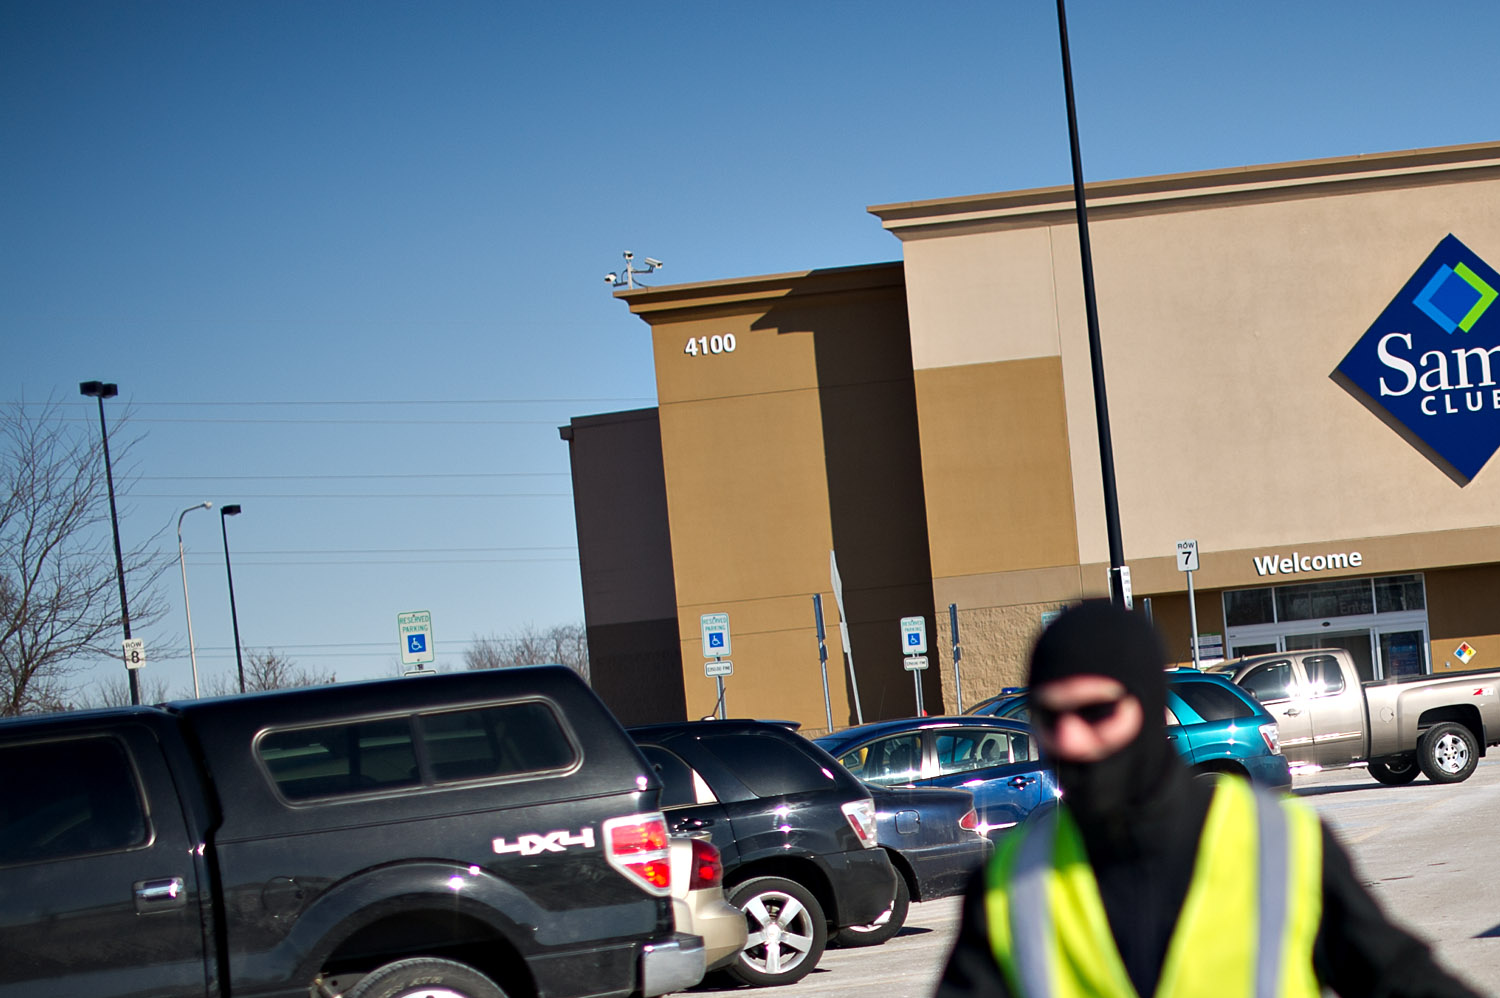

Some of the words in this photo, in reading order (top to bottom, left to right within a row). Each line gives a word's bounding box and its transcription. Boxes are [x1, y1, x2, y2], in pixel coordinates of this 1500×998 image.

[685, 333, 737, 356] 4100
[1177, 541, 1194, 549] ROW
[1182, 551, 1192, 565] 7
[1254, 551, 1363, 576] Welcome
[399, 615, 429, 624] RESERVED
[703, 617, 727, 625] RESERVED
[402, 624, 428, 632] PARKING
[125, 641, 142, 649] ROW
[131, 650, 140, 664] 8
